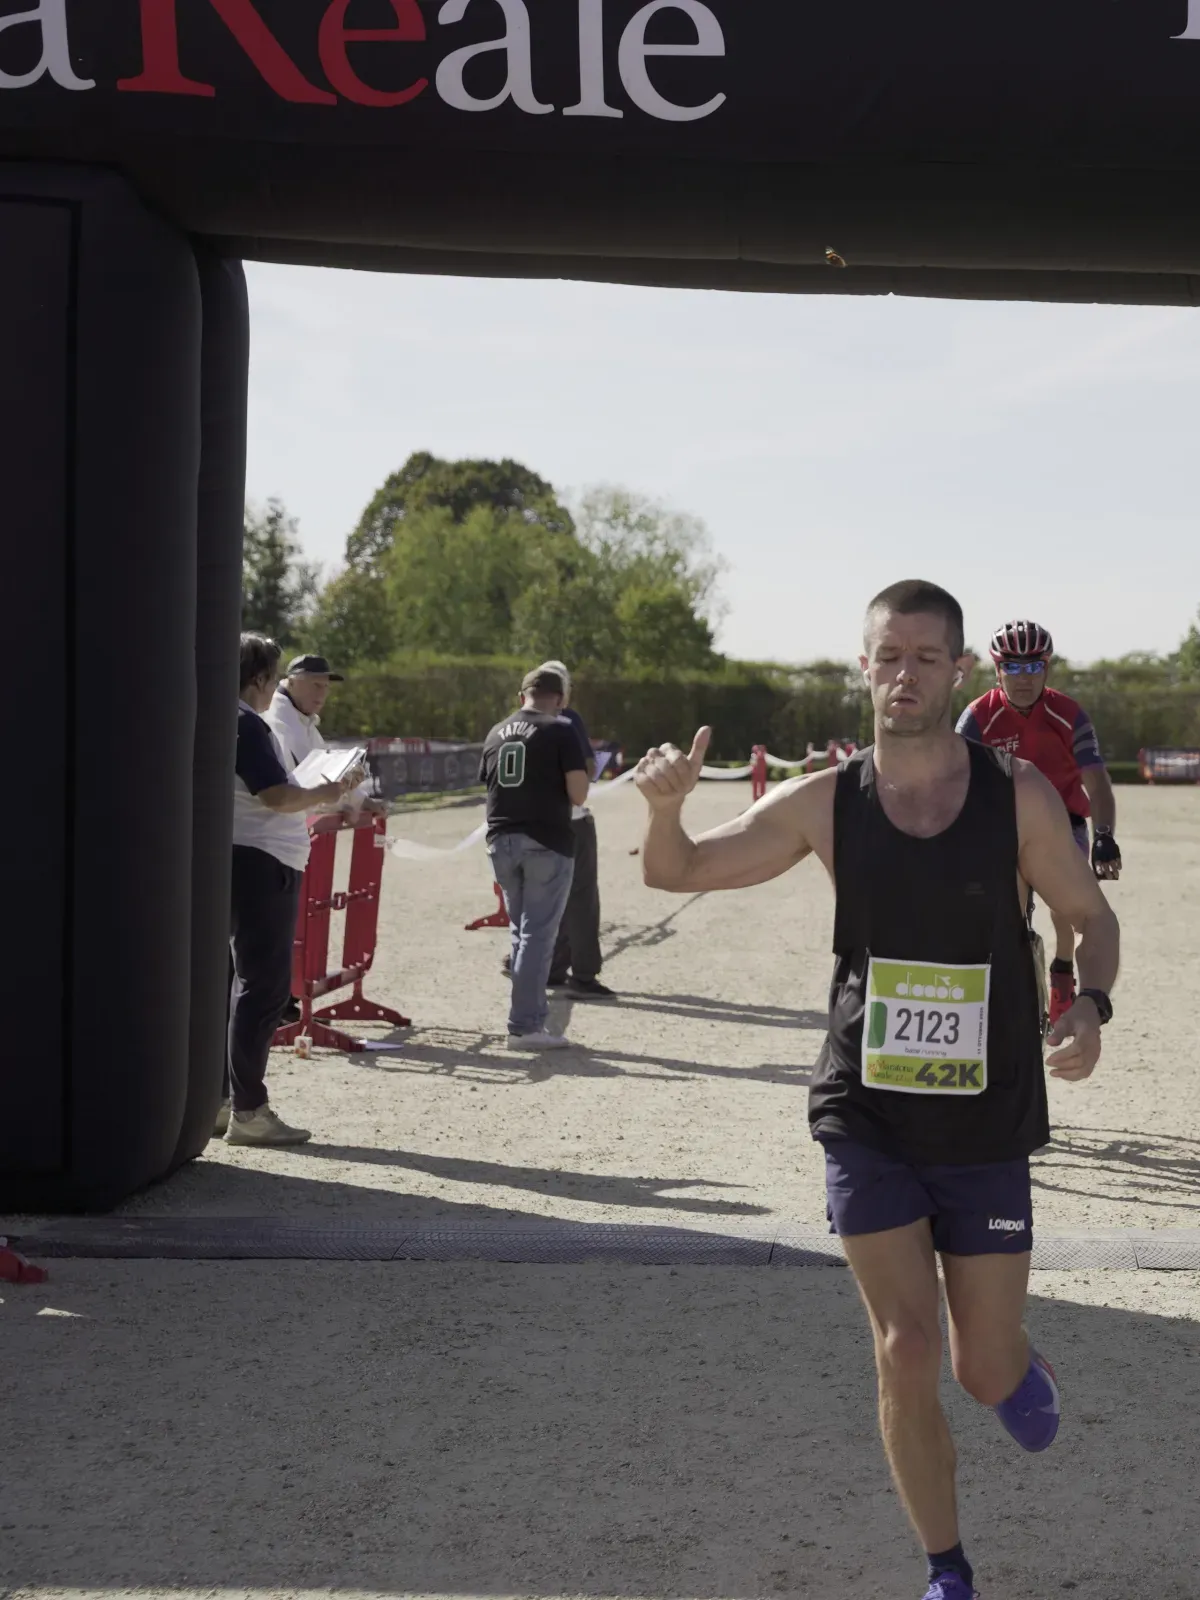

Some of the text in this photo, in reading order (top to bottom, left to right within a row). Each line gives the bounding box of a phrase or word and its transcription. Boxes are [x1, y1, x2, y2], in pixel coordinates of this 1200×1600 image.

[497, 721, 538, 741] TATUM
[497, 741, 527, 788] 0
[895, 971, 965, 1000] diadora
[894, 1007, 961, 1045] 2123
[914, 1062, 982, 1088] 42K
[988, 1217, 1026, 1231] LONDON
